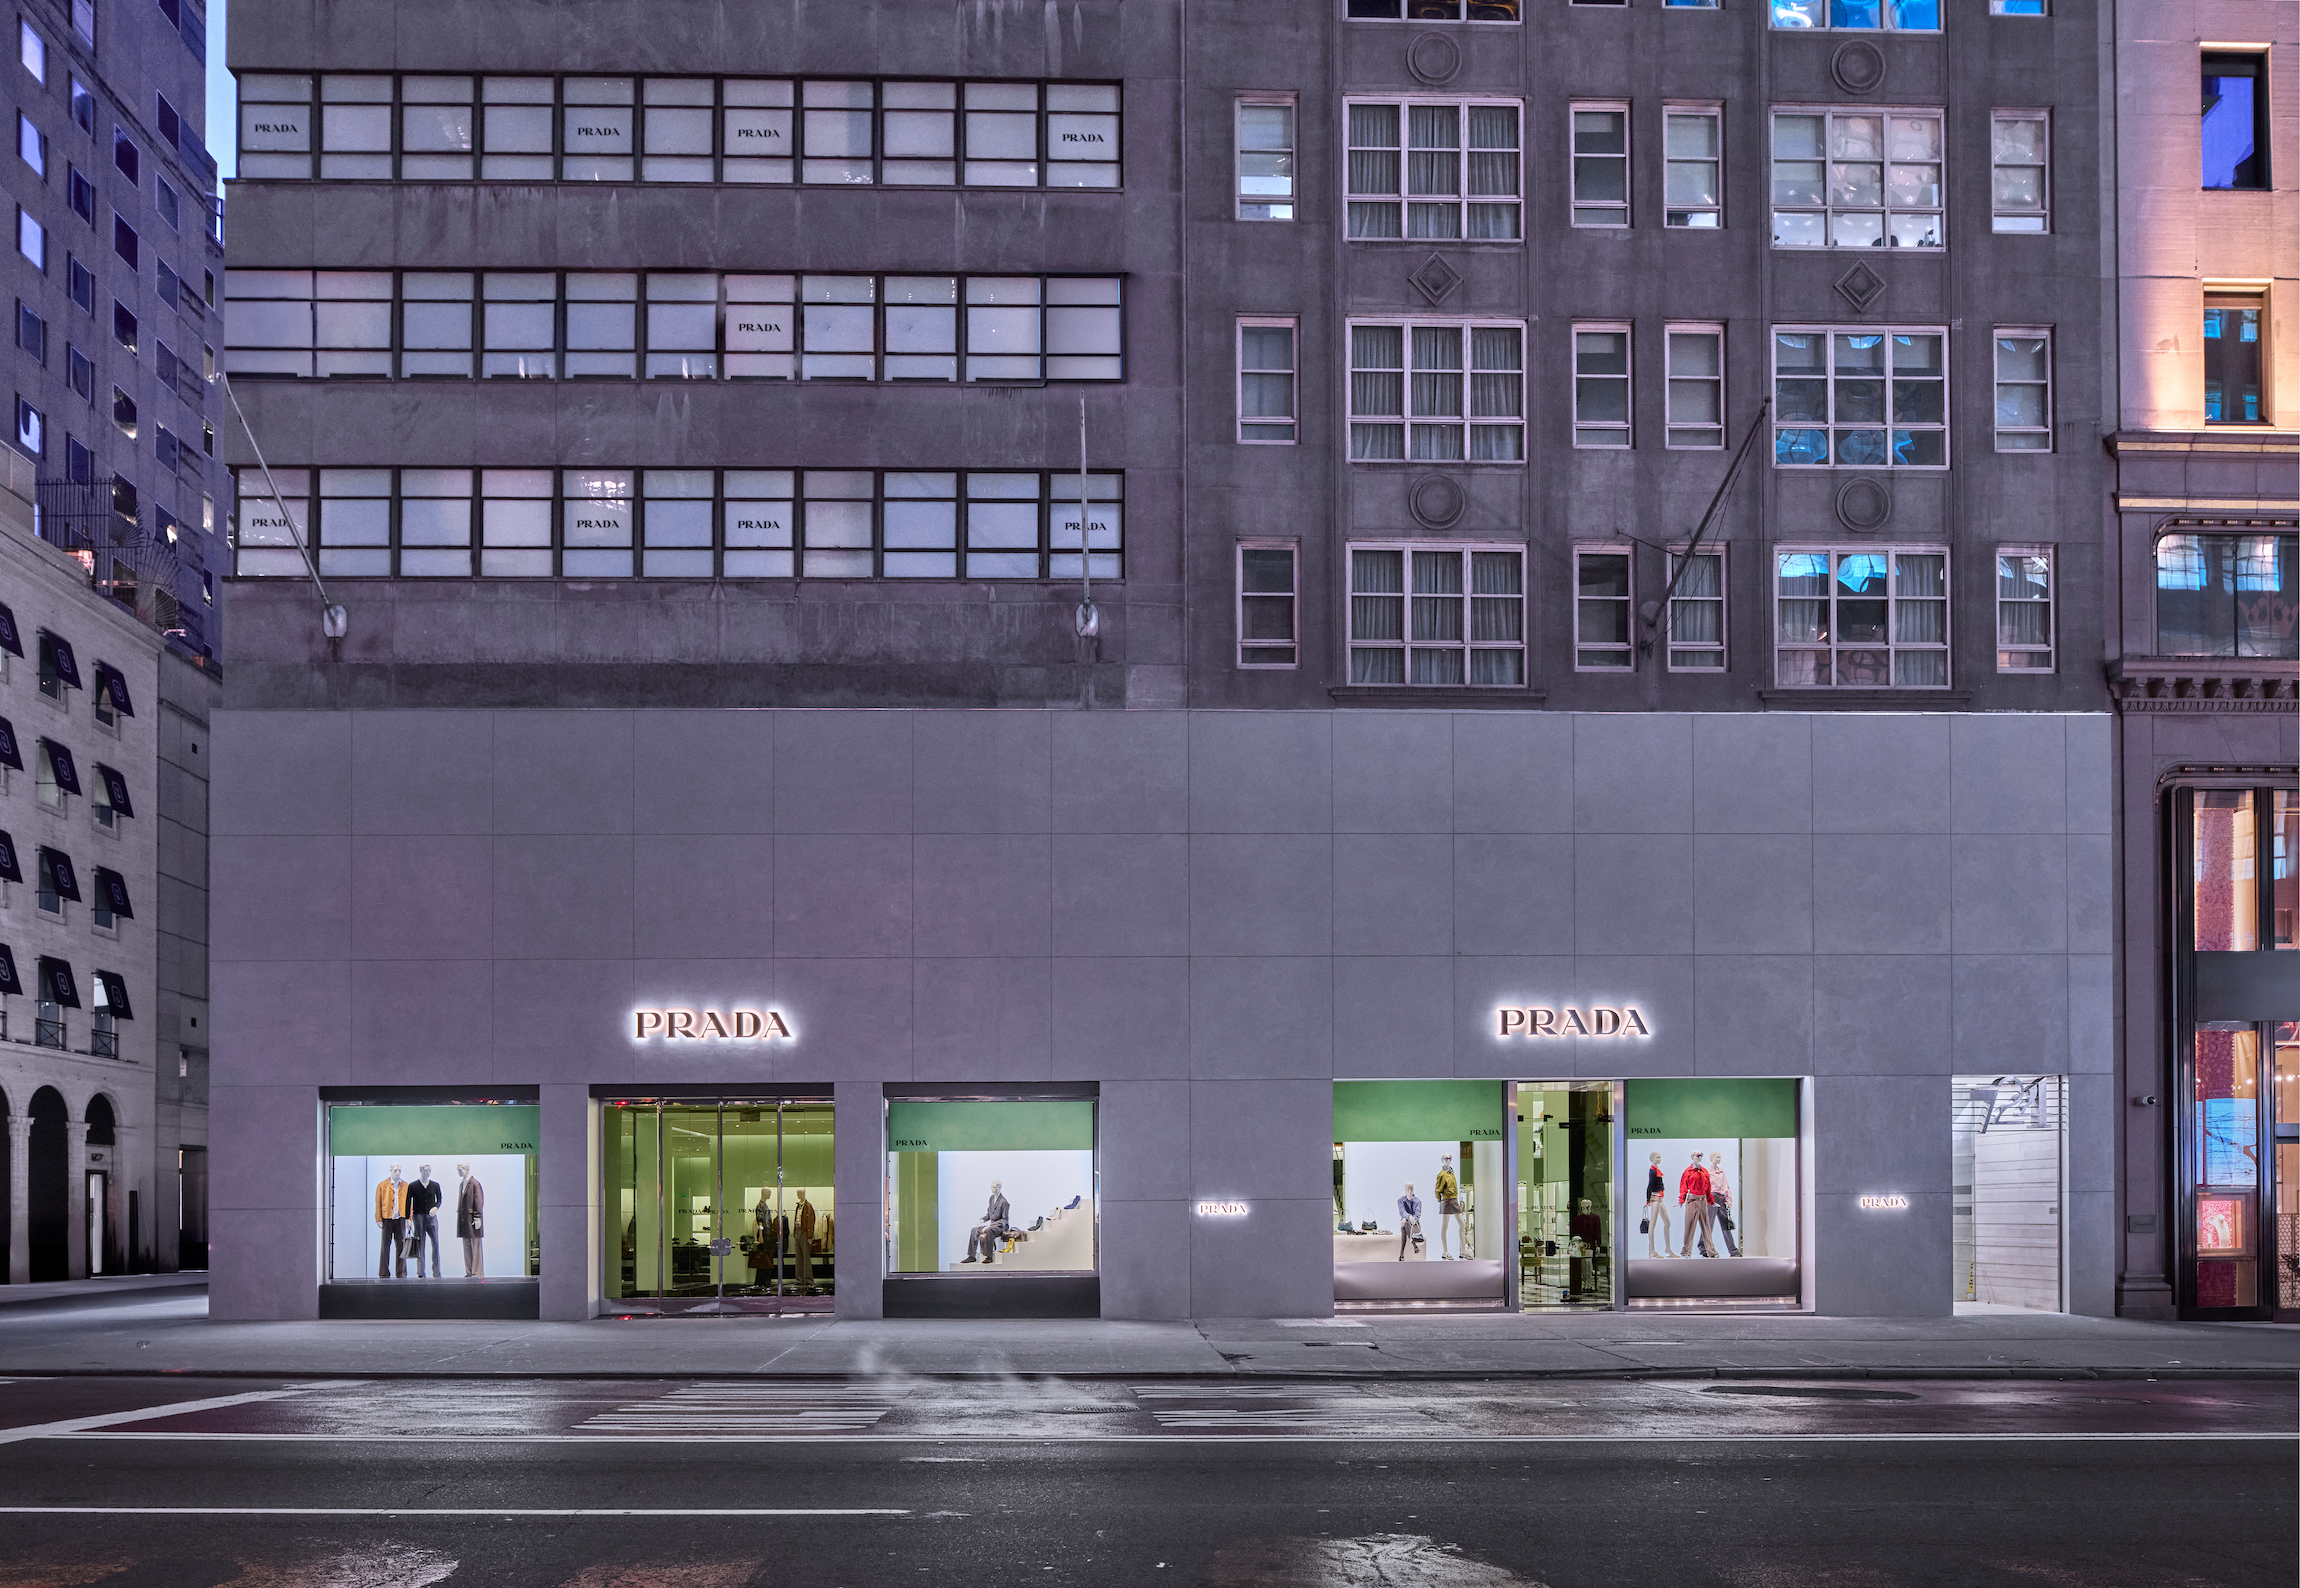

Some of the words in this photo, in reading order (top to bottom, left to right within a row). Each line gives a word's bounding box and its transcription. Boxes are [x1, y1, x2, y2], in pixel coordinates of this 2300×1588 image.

[255, 124, 298, 133] PRADA
[577, 128, 620, 136] PRADA
[738, 129, 780, 137] PRADA
[1062, 134, 1104, 142] PRADA
[739, 323, 781, 332] PRADA
[252, 518, 290, 527] PRAD
[577, 520, 620, 528] PRADA
[738, 520, 780, 529] PRADA
[1065, 522, 1107, 531] PRDA
[635, 1012, 793, 1039] PRADA
[1498, 1009, 1650, 1036] PRADA
[1970, 1076, 2051, 1134] 724
[1862, 1198, 1907, 1207] PRADA
[1200, 1204, 1247, 1214] PRADA
